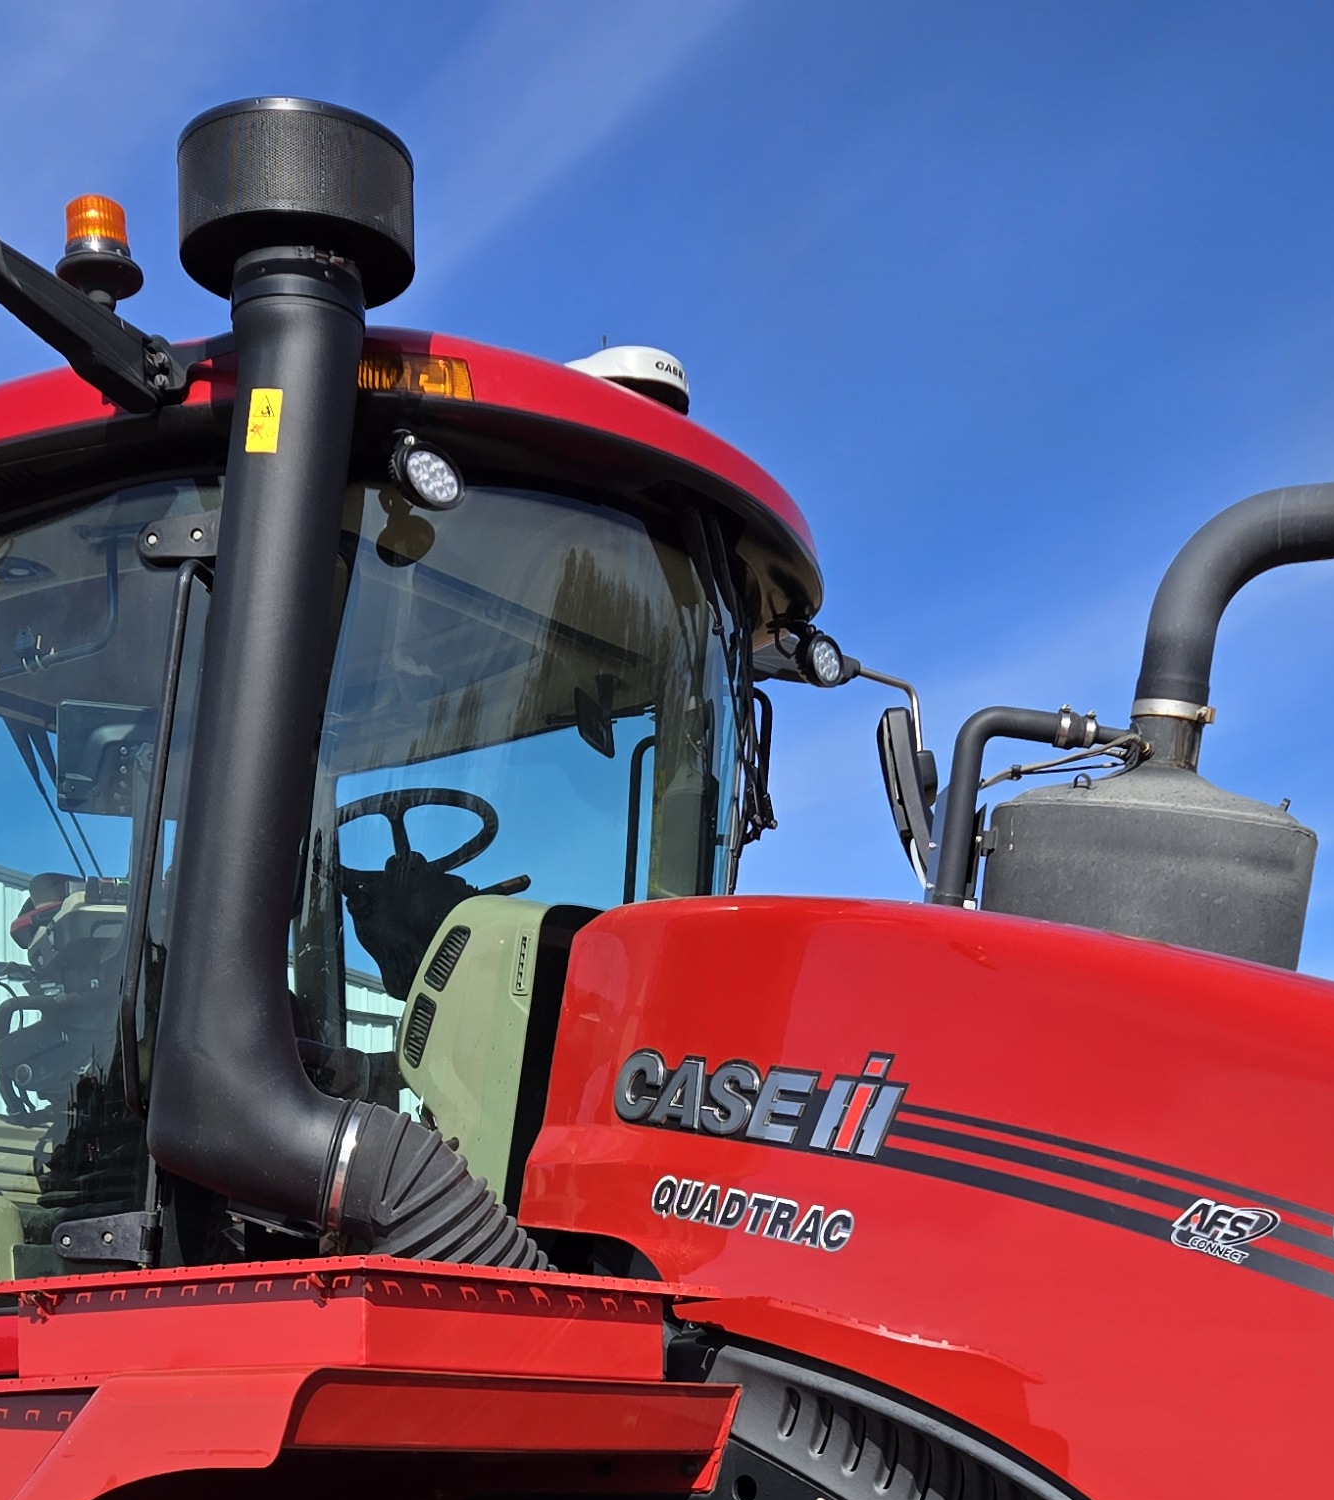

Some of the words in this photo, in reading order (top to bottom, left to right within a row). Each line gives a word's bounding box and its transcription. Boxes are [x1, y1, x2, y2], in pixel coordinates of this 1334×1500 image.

[614, 1048, 821, 1144] CASE
[651, 1175, 854, 1251] QUADTRAC
[1173, 1199, 1260, 1243] AFS
[1189, 1236, 1249, 1264] CONNECT
